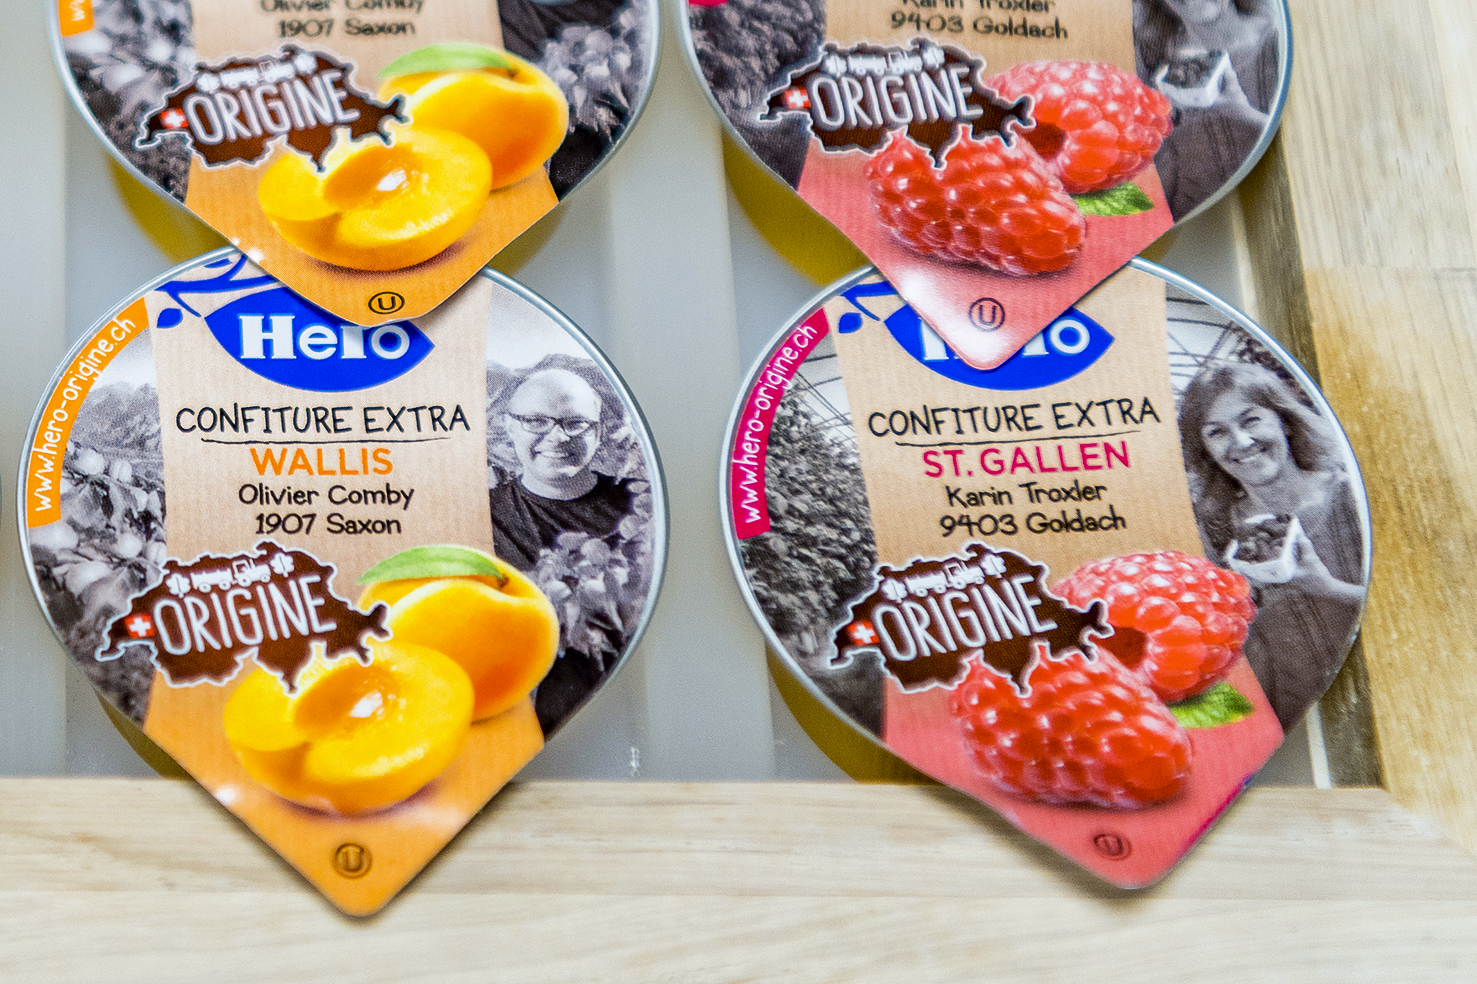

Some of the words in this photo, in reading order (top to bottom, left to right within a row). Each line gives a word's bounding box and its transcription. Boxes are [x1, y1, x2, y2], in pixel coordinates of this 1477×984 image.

[277, 20, 334, 38] 1907
[344, 19, 416, 37] Saxon
[891, 12, 965, 31] 9403
[973, 15, 1068, 40] Goldach
[184, 71, 360, 144] ORIGINE
[811, 68, 984, 127] ORIGINE
[35, 316, 136, 512] www.hero-origine.ch
[176, 403, 352, 434] CONFITURE
[364, 403, 469, 432] EXTRA
[744, 324, 817, 523] www.hero-origine.ch
[869, 404, 1041, 438] CONFITURE
[1056, 398, 1160, 428] EXTRA
[249, 448, 393, 476] WALLIS
[923, 449, 975, 478] ST.
[982, 442, 1131, 475] GALLEN
[239, 483, 318, 506] Olivier
[327, 485, 414, 510] Comby
[947, 484, 1012, 506] Karin
[1022, 481, 1106, 503] Troxler
[255, 513, 316, 535] 1907
[326, 514, 401, 535] Saxon
[939, 515, 1017, 537] 9403
[1027, 506, 1126, 534] Goldach
[153, 575, 336, 656] ORIGINE
[874, 575, 1057, 662] ORIGINE
